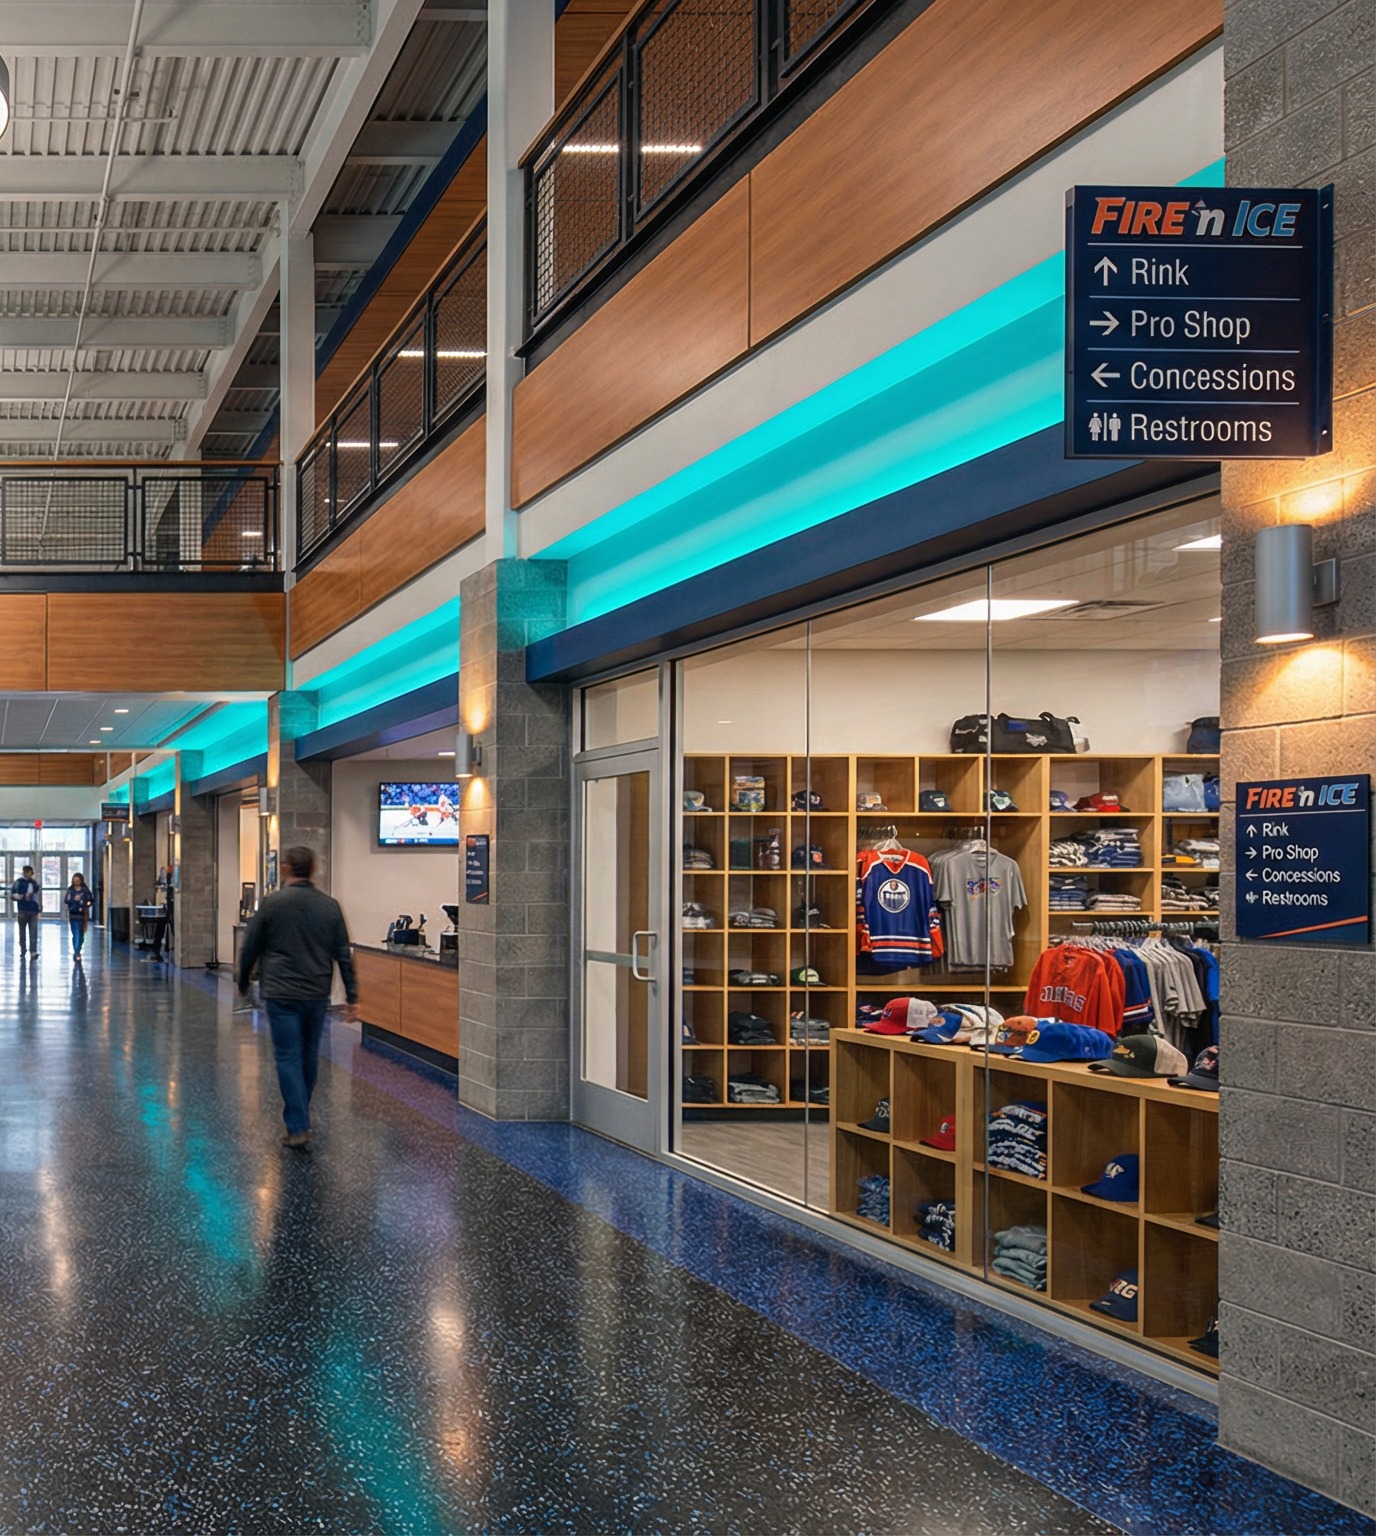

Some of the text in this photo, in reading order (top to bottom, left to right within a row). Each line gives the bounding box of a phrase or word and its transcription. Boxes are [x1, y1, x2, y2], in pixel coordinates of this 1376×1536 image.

[1091, 197, 1190, 235] FIRE
[1232, 200, 1302, 237] ICE
[1131, 258, 1190, 286] Rink
[1131, 309, 1251, 345] Pro Shop
[1130, 361, 1296, 391] Concessions
[1131, 413, 1273, 442] Restrooms
[1246, 787, 1297, 810] FIRE
[1318, 783, 1359, 806] ICE
[1262, 822, 1290, 837] Rink
[1262, 844, 1319, 863] Pro Shop
[1262, 867, 1341, 883] Concessions
[1262, 890, 1329, 906] Restrooms
